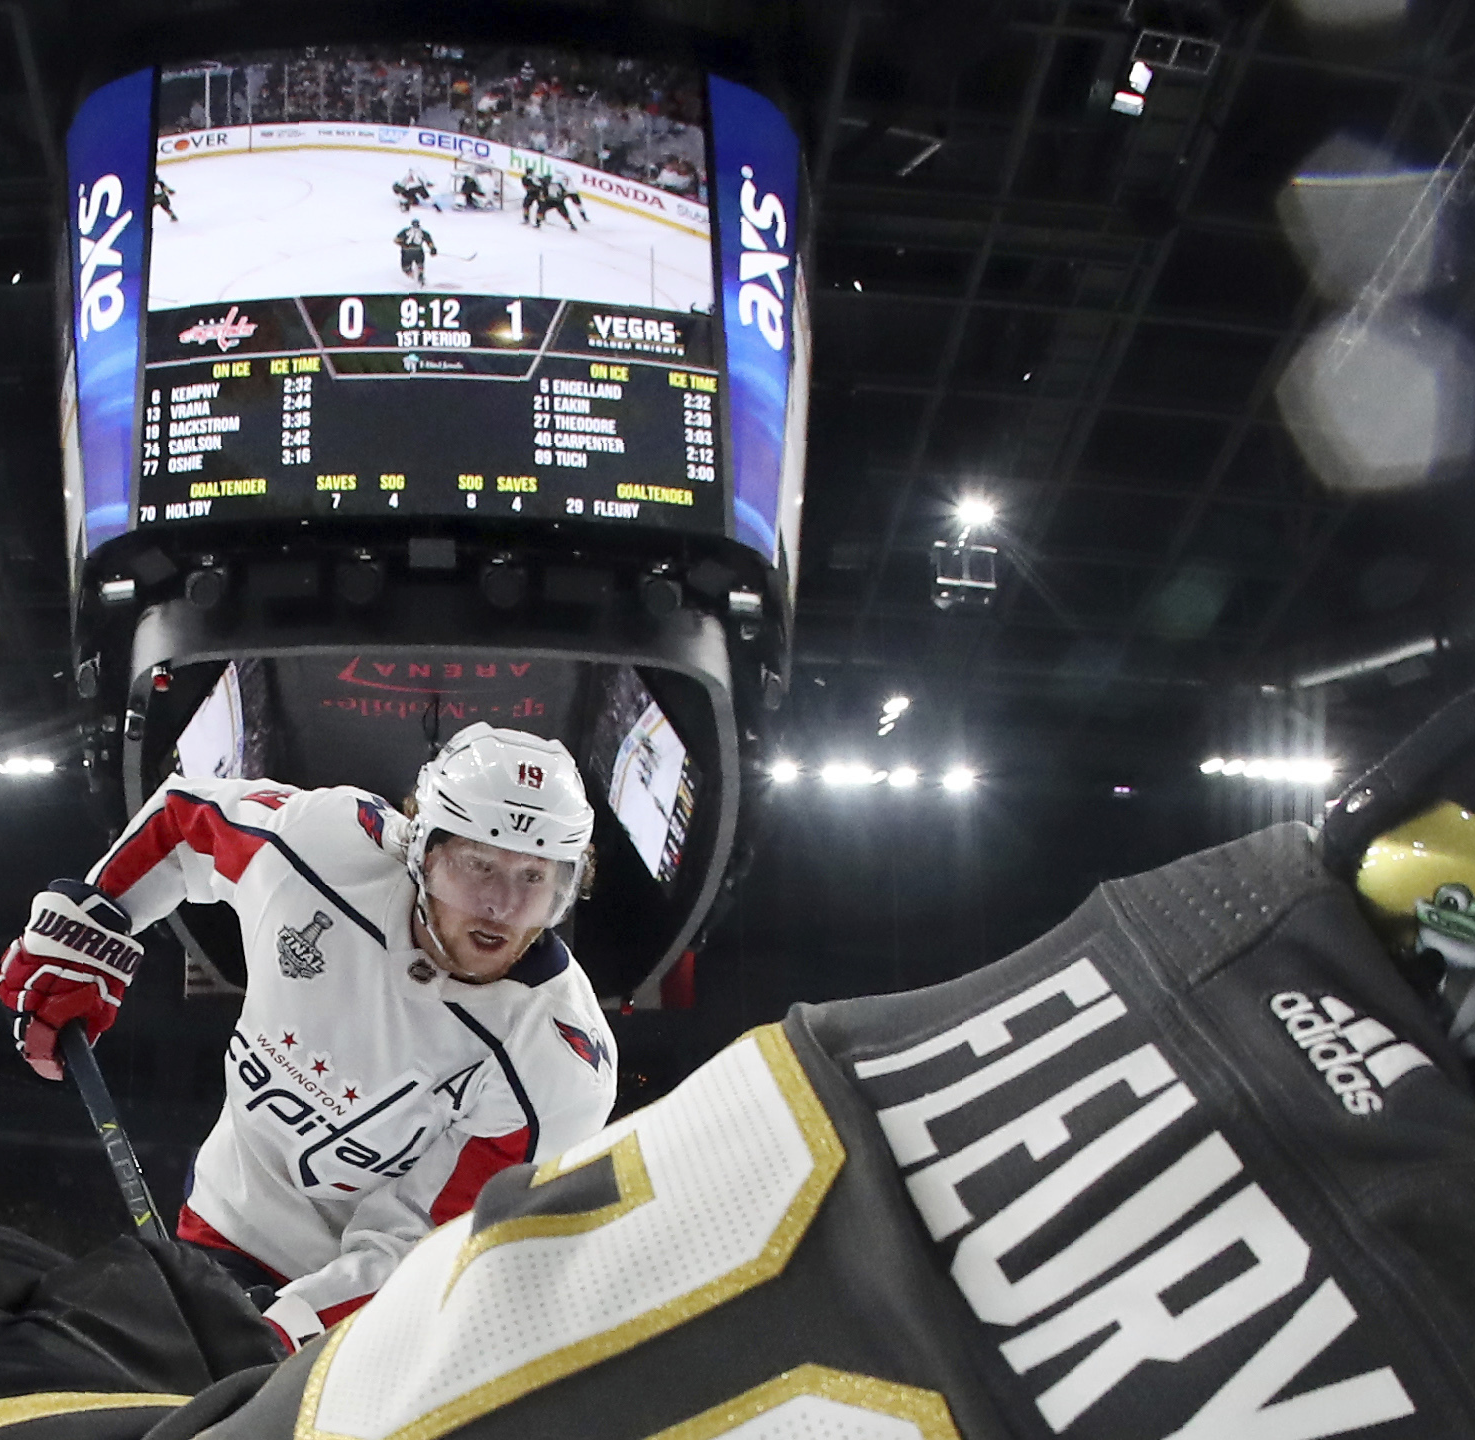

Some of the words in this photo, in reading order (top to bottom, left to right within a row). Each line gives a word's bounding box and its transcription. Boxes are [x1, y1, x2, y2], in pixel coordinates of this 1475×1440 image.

[419, 131, 490, 158] GEICO
[580, 172, 667, 211] HONDA
[338, 297, 364, 340] 0
[400, 298, 461, 329] 9:12
[506, 299, 523, 342] 1
[593, 314, 676, 344] VEGAS
[396, 331, 420, 348] 1ST
[422, 331, 471, 348] PERIOD
[213, 363, 229, 379] ON
[232, 361, 251, 377] ICE
[271, 358, 289, 375] ICE
[292, 356, 320, 373] TIME
[590, 363, 607, 380] ON
[609, 365, 629, 382] ICE
[171, 383, 220, 402] KEMPNY
[283, 377, 312, 393] 2:32
[540, 378, 549, 393] 5
[552, 379, 622, 400] ENGELLAND
[683, 393, 712, 411] 2:32
[668, 371, 687, 389] ICE
[689, 374, 717, 393] TIME
[146, 407, 161, 422] 13
[171, 401, 211, 419] VRANA
[283, 394, 312, 411] 2:44
[533, 396, 550, 411] 21
[553, 397, 591, 414] EAKIN
[684, 411, 712, 428] 2:39
[145, 425, 160, 440] 19
[169, 416, 240, 438] BACKSTROM
[282, 412, 311, 428] 3:35
[533, 414, 550, 429] 27
[553, 415, 616, 435] THEODORE
[685, 429, 713, 446] 3:03
[144, 442, 160, 458] 74
[168, 435, 222, 455] CARLSON
[282, 430, 310, 447] 2:42
[534, 431, 552, 447] 40
[554, 433, 625, 453] CARPENTER
[686, 446, 714, 464] 2:12
[143, 460, 159, 476] 77
[168, 454, 203, 473] OSHIE
[282, 449, 311, 465] 3:16
[534, 450, 552, 465] 89
[555, 451, 587, 468] TUCH
[687, 464, 715, 482] 3:00
[190, 478, 267, 499] GOALTENDER
[316, 474, 357, 491] SAVES
[380, 474, 405, 490] SOG
[458, 474, 484, 491] SOG
[497, 475, 538, 493] SAVES
[617, 483, 693, 506] GOALTENDER
[140, 505, 156, 522] 70
[165, 500, 212, 520] HOLTBY
[331, 493, 341, 509] 7
[388, 493, 399, 508] 4
[511, 495, 522, 512] 4
[566, 498, 584, 515] 29
[594, 500, 640, 519] FLEURY
[372, 663, 531, 678] ARENA
[518, 762, 544, 789] 19
[30, 908, 142, 976] WARRIO
[279, 929, 325, 973] FINAL
[1270, 990, 1384, 1116] adidas
[256, 1034, 347, 1117] WASHINGTON
[432, 1060, 485, 1111] A
